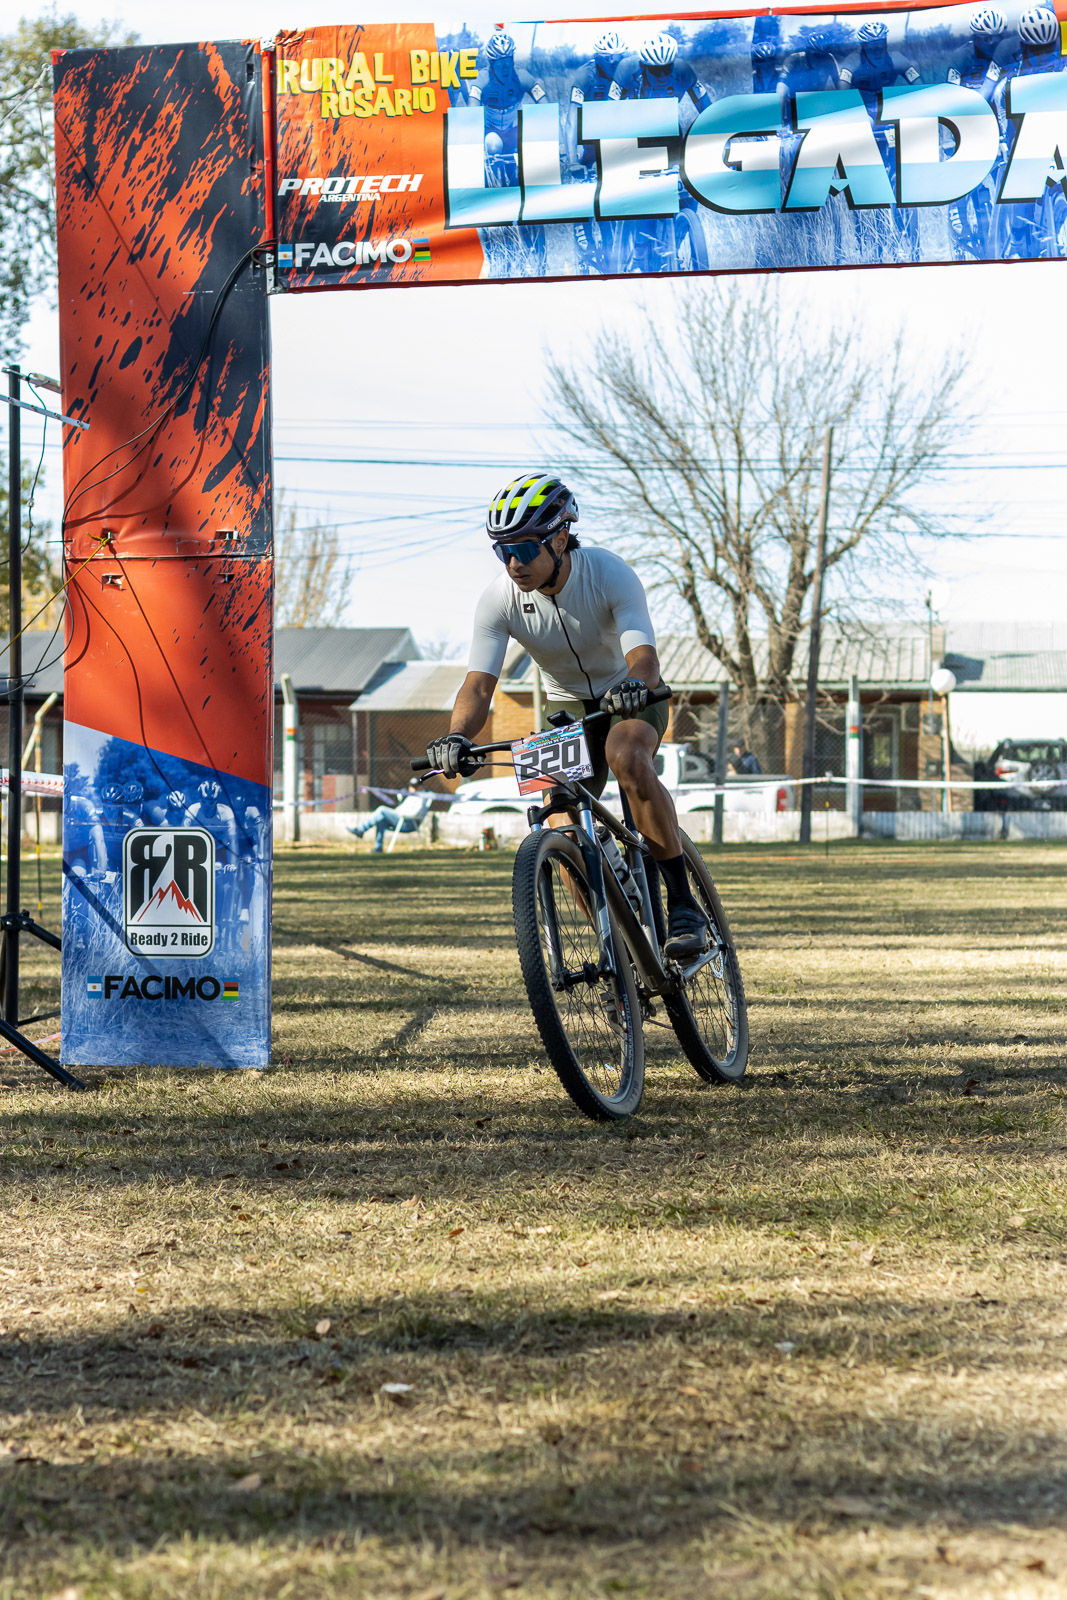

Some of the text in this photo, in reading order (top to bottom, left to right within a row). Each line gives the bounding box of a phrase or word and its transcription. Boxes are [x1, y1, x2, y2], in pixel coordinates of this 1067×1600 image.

[277, 48, 478, 95] RURAL BIKE
[320, 86, 437, 118] ROSARIO
[277, 173, 424, 196] PROTECH
[318, 192, 382, 203] ARGENTINA
[294, 238, 412, 267] FACIMO
[520, 738, 581, 781] 220
[130, 931, 208, 948] Ready 2 Ride
[104, 975, 221, 1001] FACIMO
